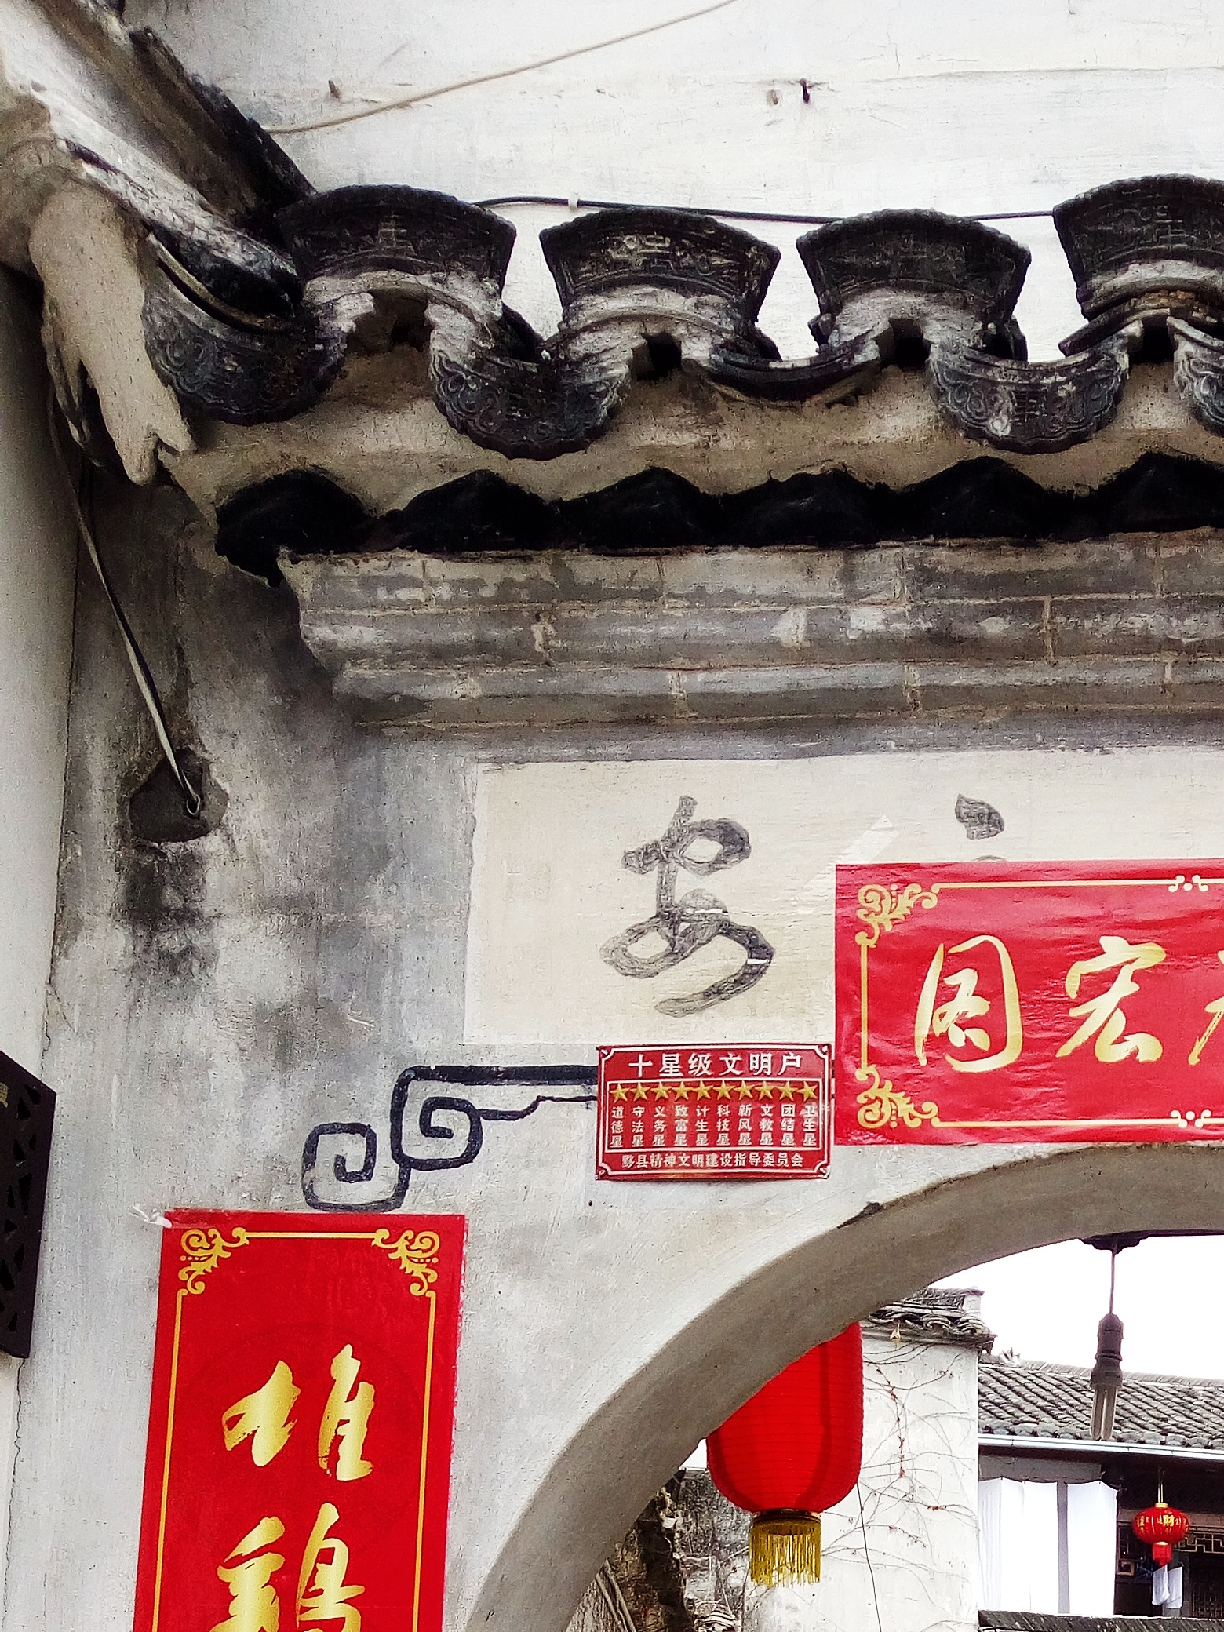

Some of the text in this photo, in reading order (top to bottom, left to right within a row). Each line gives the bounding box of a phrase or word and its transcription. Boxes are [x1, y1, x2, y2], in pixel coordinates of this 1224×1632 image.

[628, 1052, 803, 1077] 十星级文明户
[610, 1105, 624, 1147] 道德星
[632, 1105, 645, 1147] 守法星
[653, 1105, 667, 1147] 义务星
[674, 1105, 688, 1147] 致富星
[695, 1105, 709, 1147] 计生星
[717, 1105, 731, 1147] 科技星
[738, 1105, 752, 1147] 新风星
[760, 1105, 774, 1147] 文教星
[781, 1105, 796, 1147] 团结星
[802, 1105, 817, 1147] 卫生星
[621, 1152, 804, 1169] 黟县精神文明建设指导委员会
